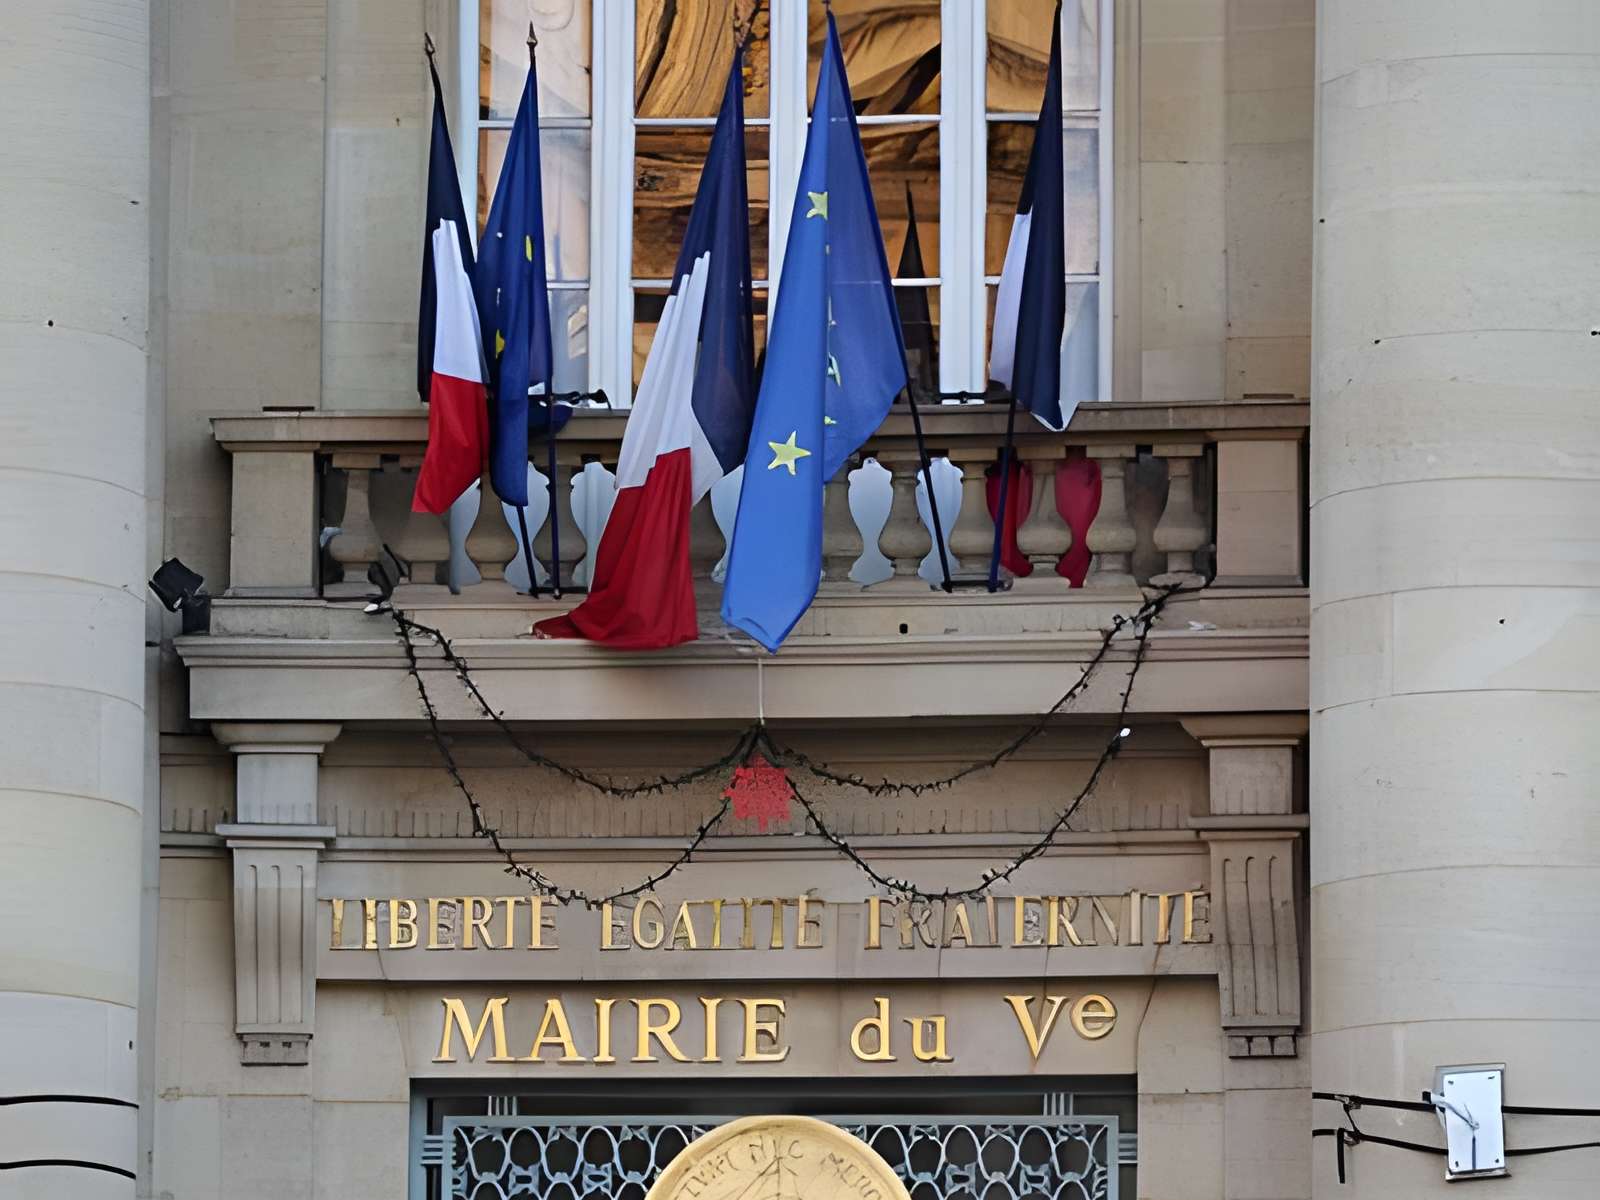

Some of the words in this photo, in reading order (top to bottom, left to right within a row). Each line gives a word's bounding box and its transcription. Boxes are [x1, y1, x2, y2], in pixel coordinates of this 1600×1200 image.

[329, 895, 560, 951] LIBERTE
[431, 996, 791, 1063] MAIRIE
[850, 996, 954, 1063] du
[1003, 993, 1117, 1060] Ve
